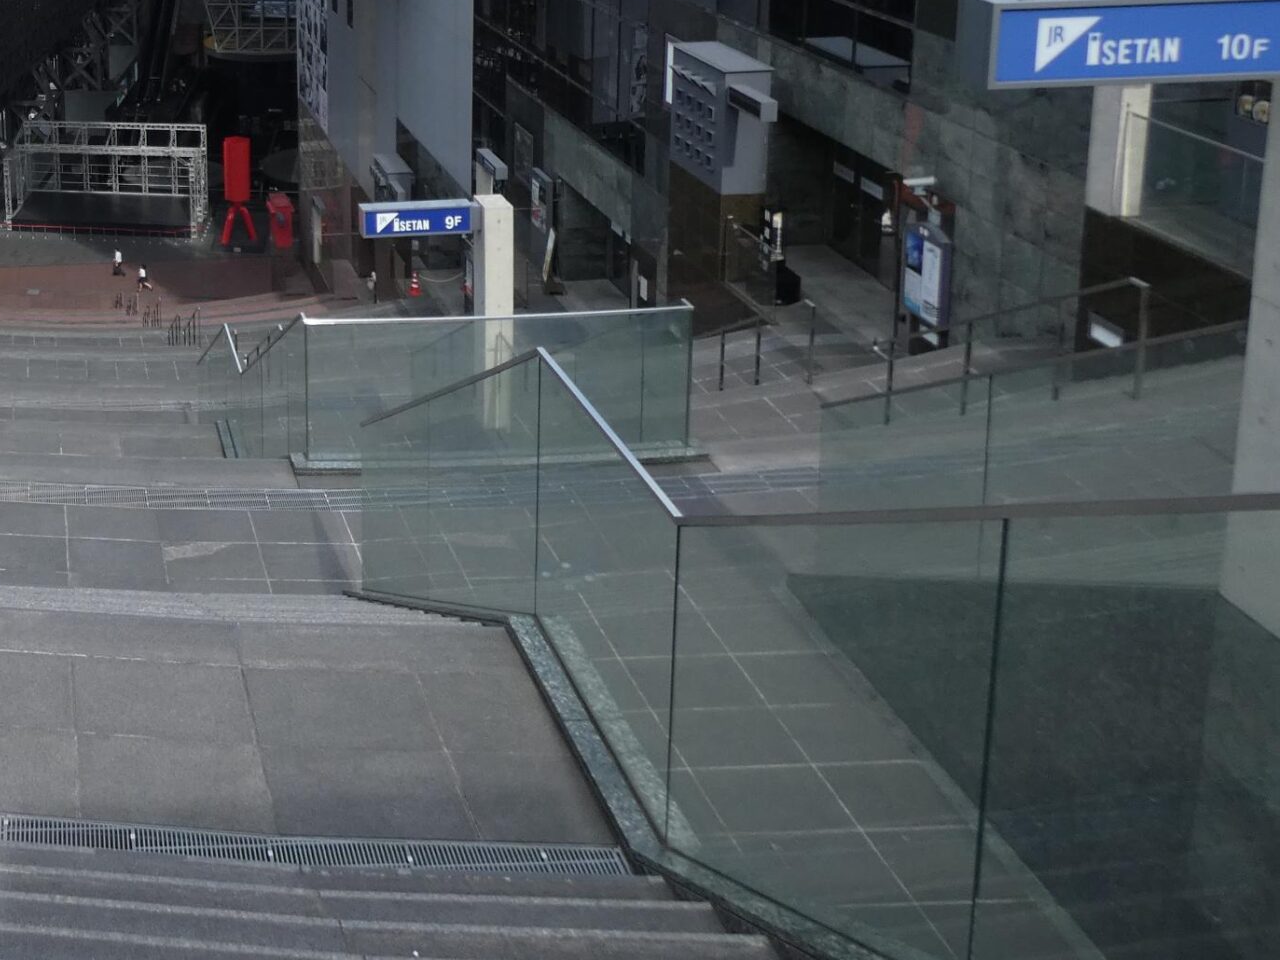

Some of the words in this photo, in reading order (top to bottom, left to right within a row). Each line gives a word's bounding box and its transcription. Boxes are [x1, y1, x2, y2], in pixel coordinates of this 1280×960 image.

[1046, 25, 1064, 48] JR
[1217, 33, 1271, 61] 10F
[445, 216, 462, 230] 9F
